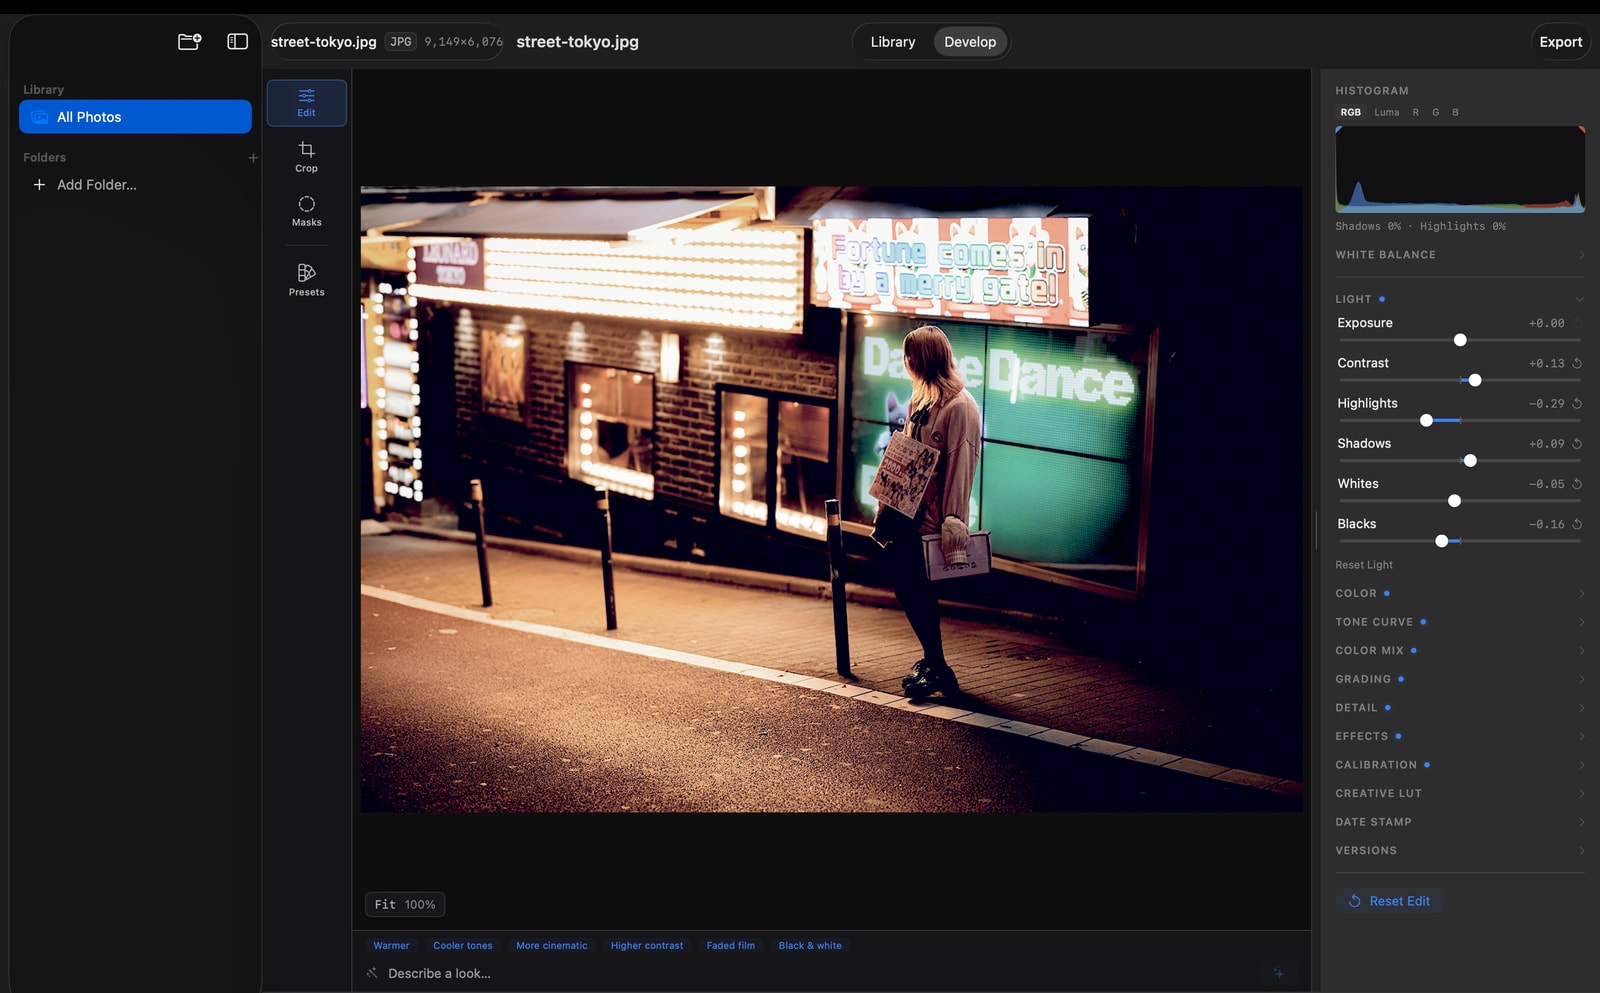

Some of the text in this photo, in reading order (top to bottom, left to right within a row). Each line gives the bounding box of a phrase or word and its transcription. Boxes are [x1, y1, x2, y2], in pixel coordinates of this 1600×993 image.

[270, 35, 377, 51] street-tokyo.jpg
[390, 36, 412, 47] JPG
[516, 34, 640, 52] street-tokyo.jpg
[871, 35, 917, 51] Library
[944, 35, 997, 51] Develop
[1539, 35, 1584, 51] Export
[23, 83, 65, 97] Library
[1335, 86, 1409, 96] HISTOGRAM
[56, 110, 123, 124] All Photos
[296, 107, 316, 118] Edit
[1340, 107, 1362, 117] RGB
[1373, 107, 1400, 117] Luma
[1412, 107, 1419, 117] R
[1432, 107, 1440, 117] G
[1452, 107, 1459, 117] B
[23, 151, 67, 163] Folders
[294, 163, 319, 175] Crop
[56, 178, 83, 191] Add
[291, 217, 323, 227] Masks
[1335, 221, 1402, 231] Shadows 0%
[1420, 220, 1507, 233] Highlights 0%
[830, 234, 1065, 272] Fortune comes in
[1335, 249, 1436, 260] WHITE BALANCE
[838, 264, 1058, 304] by a merry gate!
[288, 287, 326, 297] Presets
[1335, 294, 1372, 304] LIGHT
[1337, 316, 1394, 331] Exposure
[1528, 318, 1565, 328] +0.00
[1337, 357, 1390, 369] Contrast
[1528, 358, 1565, 369] +0.13
[863, 335, 1135, 407] Dae Dance
[1337, 396, 1399, 411] Highlights
[1337, 437, 1392, 449] Shadows
[1529, 438, 1565, 449] +0.09
[1337, 477, 1380, 489] Whites
[1337, 517, 1377, 530] Blacks
[1335, 559, 1393, 572] Reset Light
[1335, 588, 1377, 598] COLOR
[1335, 616, 1413, 627] TONE CURVE
[1335, 645, 1404, 656] COLOR MIX
[1335, 674, 1391, 684] GRADING
[1335, 702, 1378, 713] DETAIL
[1335, 731, 1388, 741] EFFECTS
[1335, 759, 1417, 770] CALIBRATION
[1335, 788, 1422, 798] CREATIVE LUT
[1335, 817, 1412, 827] DATE STAMP
[1335, 845, 1397, 856] VERSIONS
[375, 898, 396, 910] Fit
[404, 899, 436, 910] 100%
[1369, 895, 1431, 907] Reset Edit
[373, 941, 410, 950] Warmer
[433, 940, 494, 950] Cooler tones
[515, 940, 588, 950] More cinematic
[610, 940, 684, 952] Higher contrast
[706, 940, 756, 950] Faded film
[778, 940, 843, 951] Black & white
[388, 967, 442, 979] Describe
[444, 970, 453, 979] a
